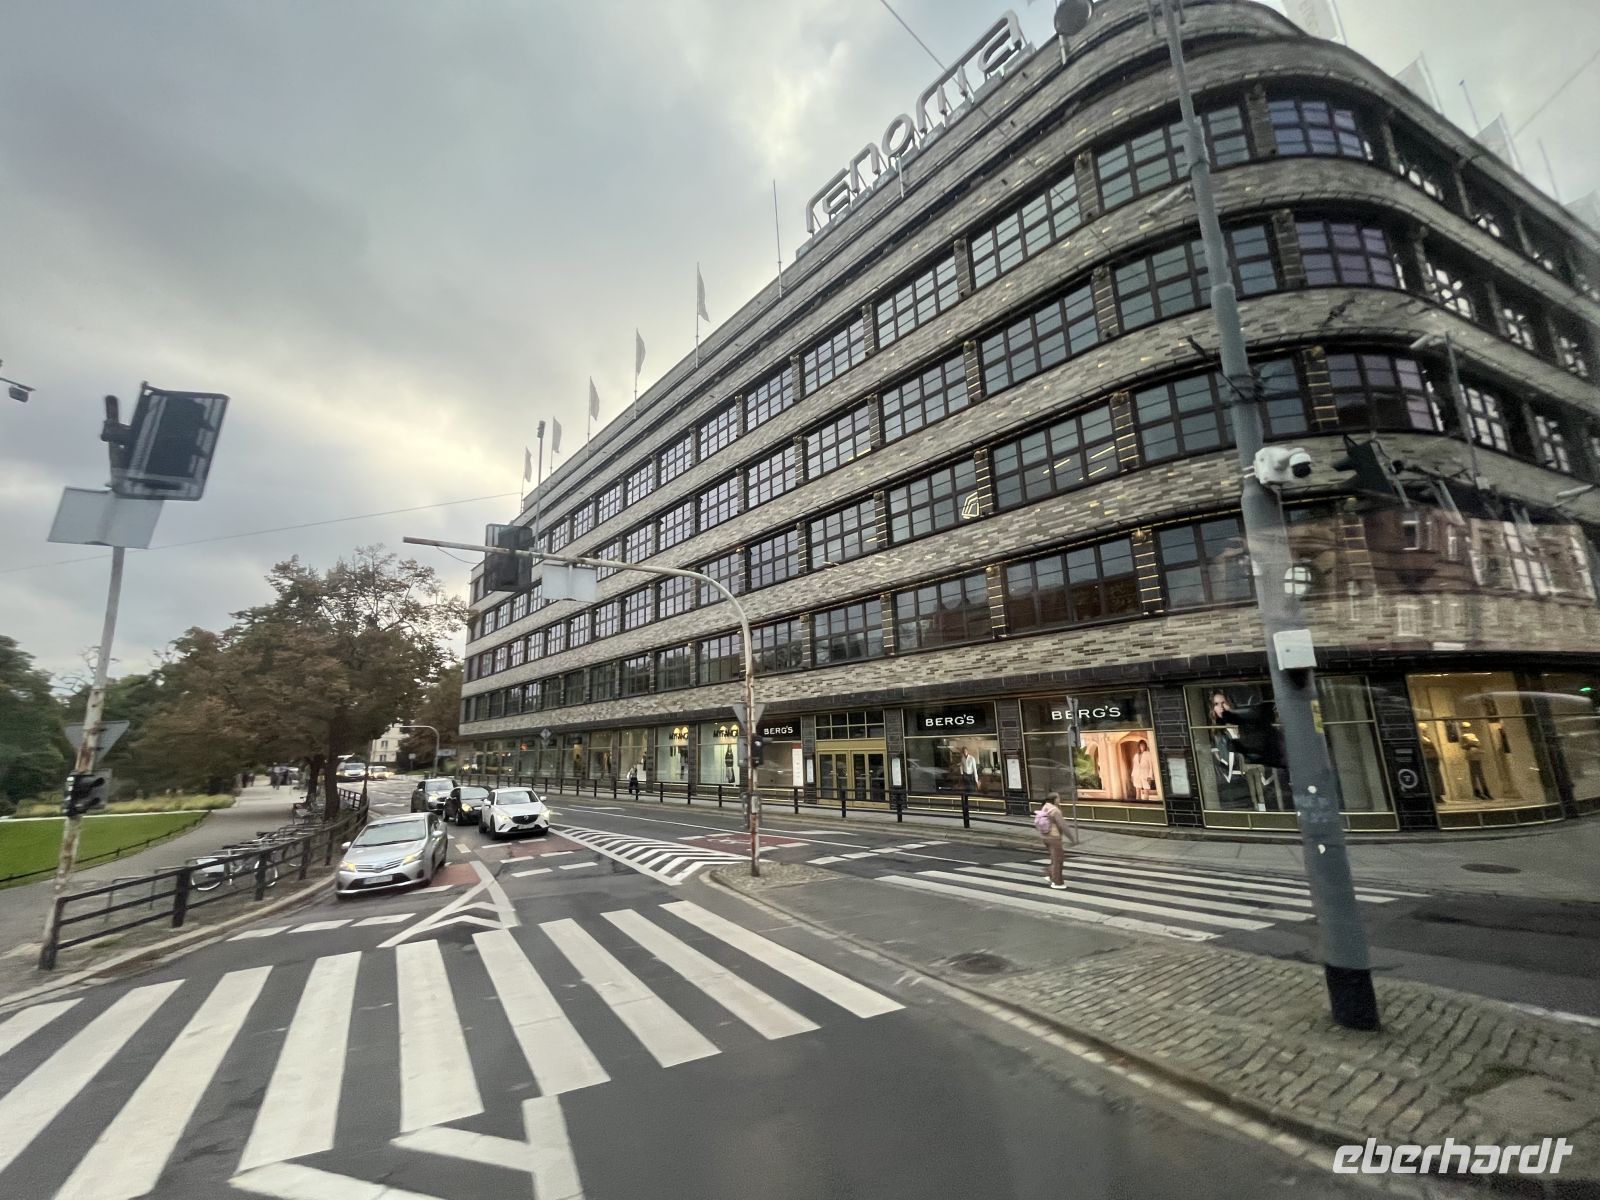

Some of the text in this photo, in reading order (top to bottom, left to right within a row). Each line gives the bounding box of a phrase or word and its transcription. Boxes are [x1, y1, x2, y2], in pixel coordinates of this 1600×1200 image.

[1051, 705, 1121, 721] BERG'S
[925, 714, 975, 727] BERG'S
[763, 726, 794, 735] BERG'S
